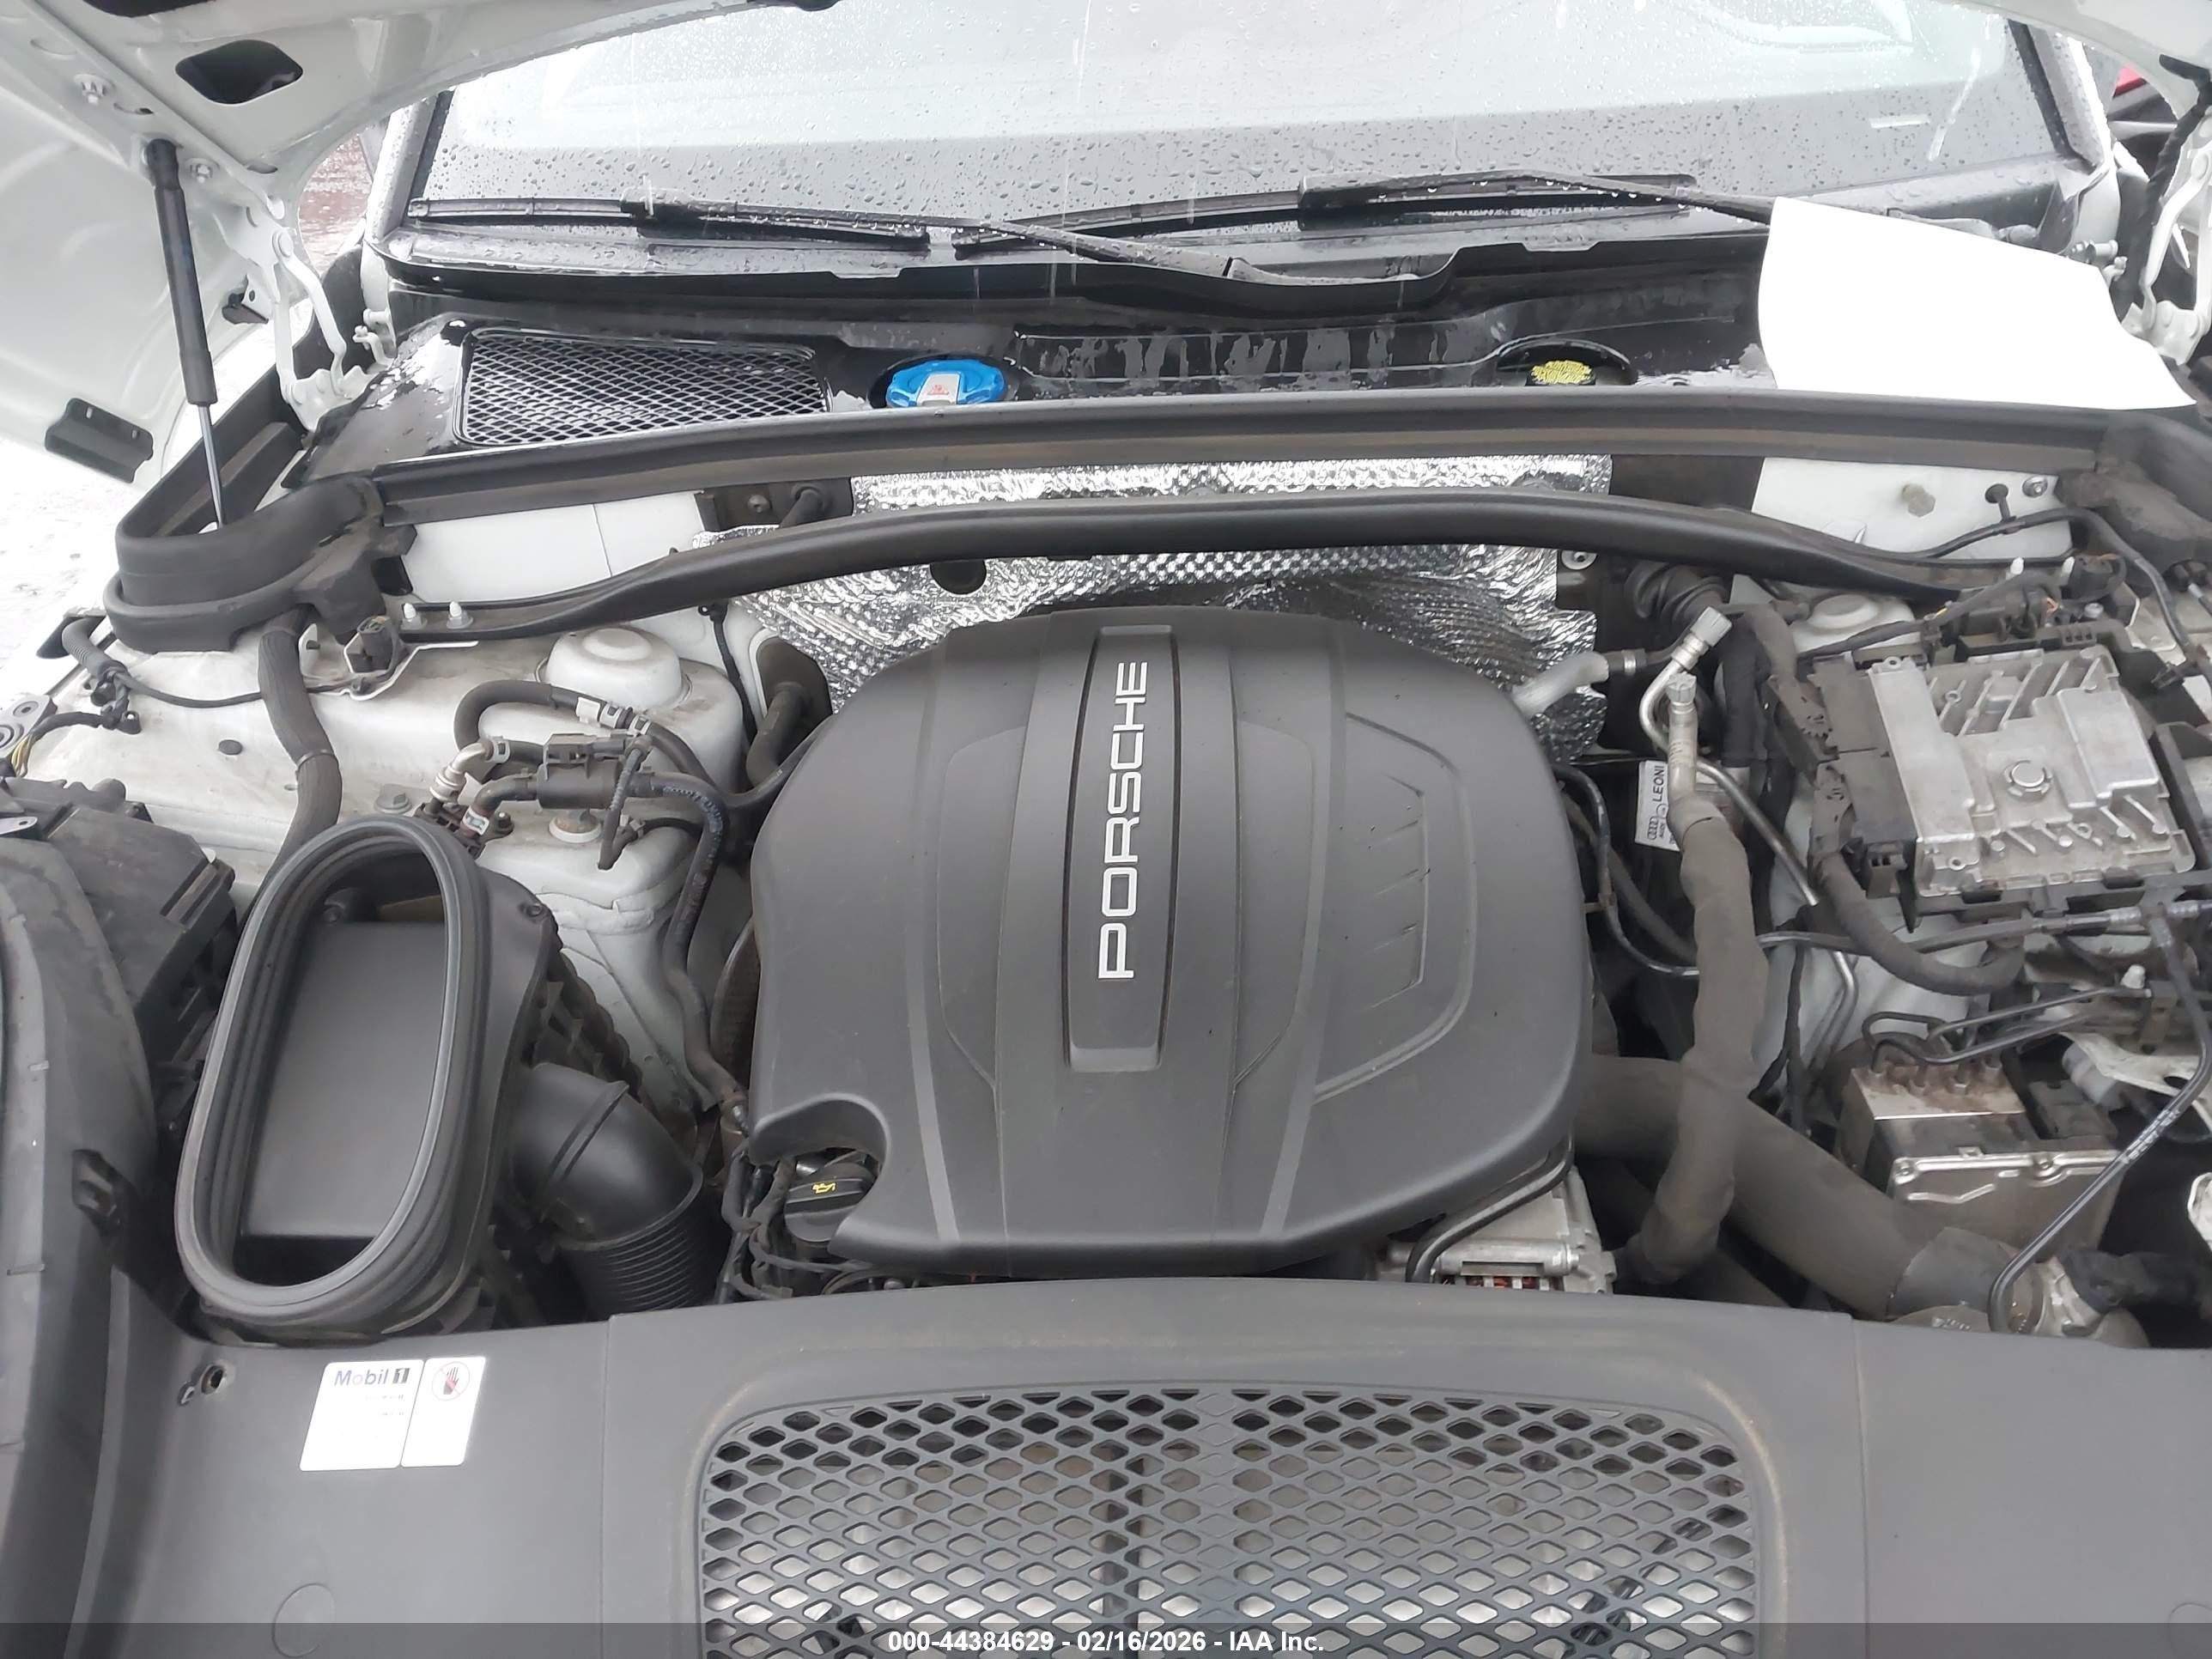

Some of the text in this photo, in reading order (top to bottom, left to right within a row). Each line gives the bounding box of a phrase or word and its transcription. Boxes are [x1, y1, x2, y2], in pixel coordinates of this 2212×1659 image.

[1652, 765, 1665, 802] LEONI
[1097, 661, 1148, 979] PORSCHE
[333, 1367, 410, 1387] Mobil 1
